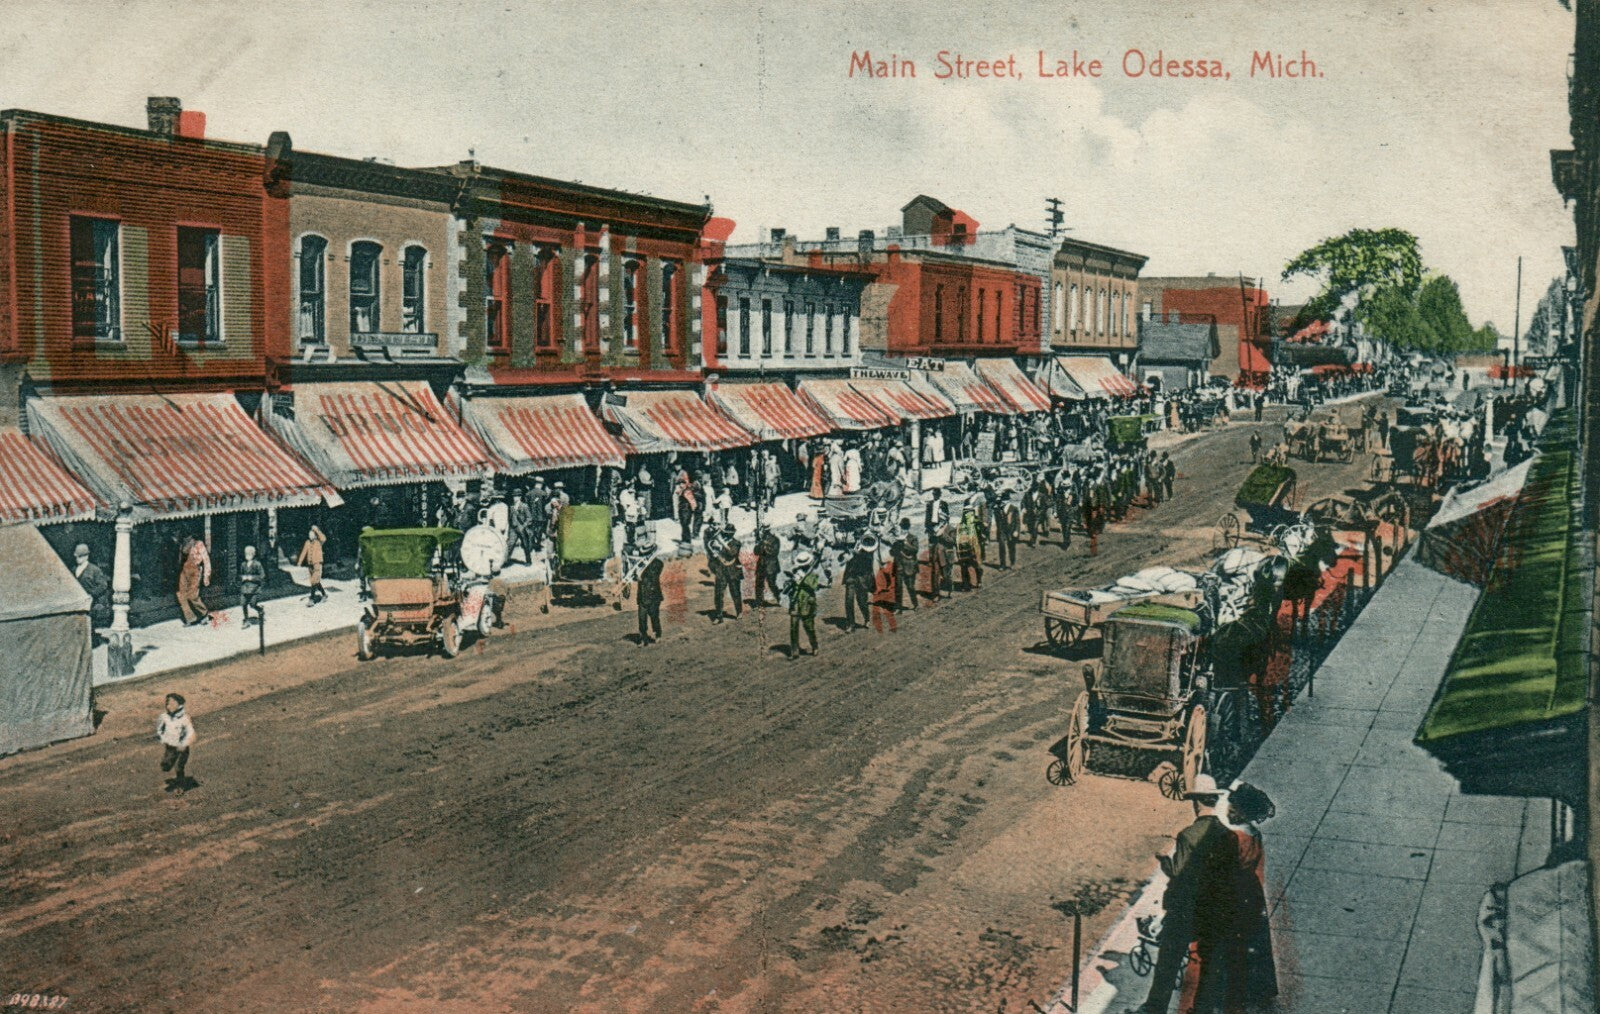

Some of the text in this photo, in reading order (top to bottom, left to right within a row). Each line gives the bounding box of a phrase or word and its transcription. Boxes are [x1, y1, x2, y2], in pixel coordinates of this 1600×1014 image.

[907, 357, 944, 371] EAT
[853, 370, 908, 379] THE WAVE
[20, 501, 72, 519] TERRY
